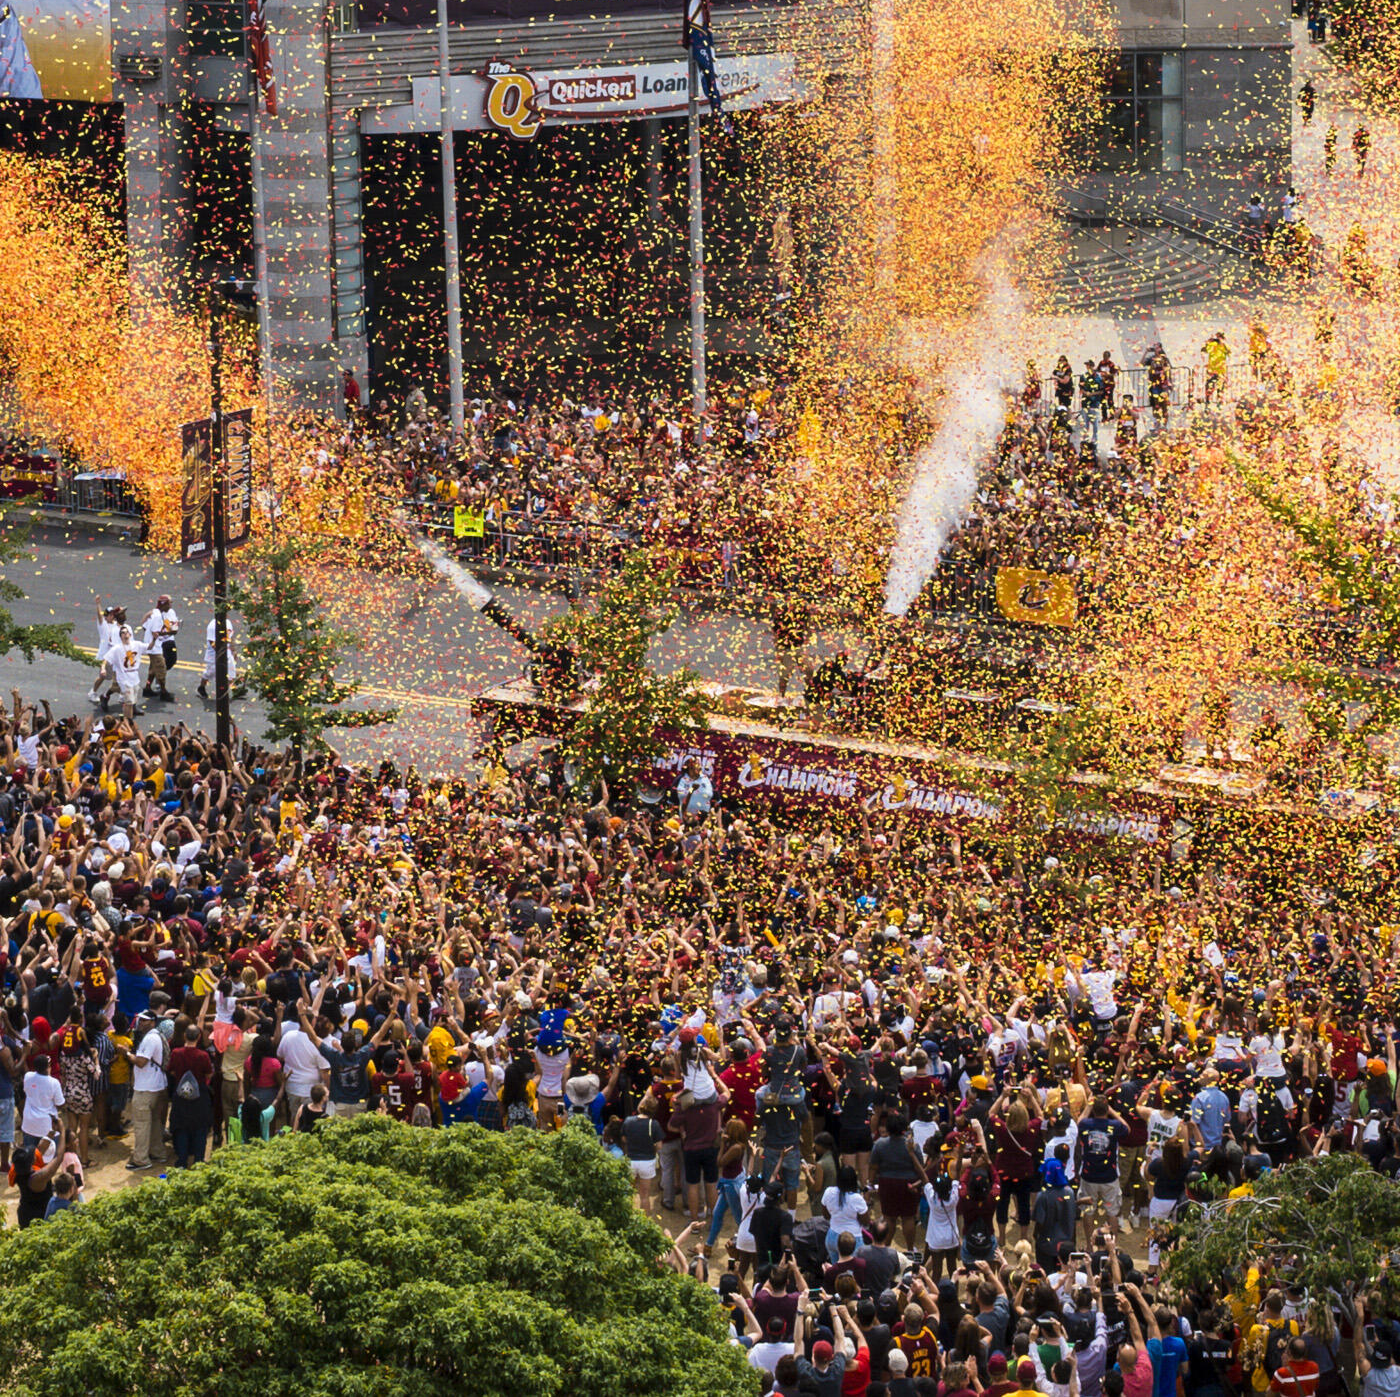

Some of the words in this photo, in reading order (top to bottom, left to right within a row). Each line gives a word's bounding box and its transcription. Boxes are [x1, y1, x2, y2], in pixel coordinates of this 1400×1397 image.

[488, 62, 511, 74] The
[551, 79, 634, 101] Quicken
[642, 75, 688, 95] Loan
[712, 68, 750, 88] rena
[487, 73, 542, 137] Q
[227, 419, 245, 540] CAVALIERS
[90, 972, 106, 987] 23
[389, 1084, 402, 1105] 5
[1335, 1084, 1346, 1102] 5
[911, 1360, 931, 1378] 23
